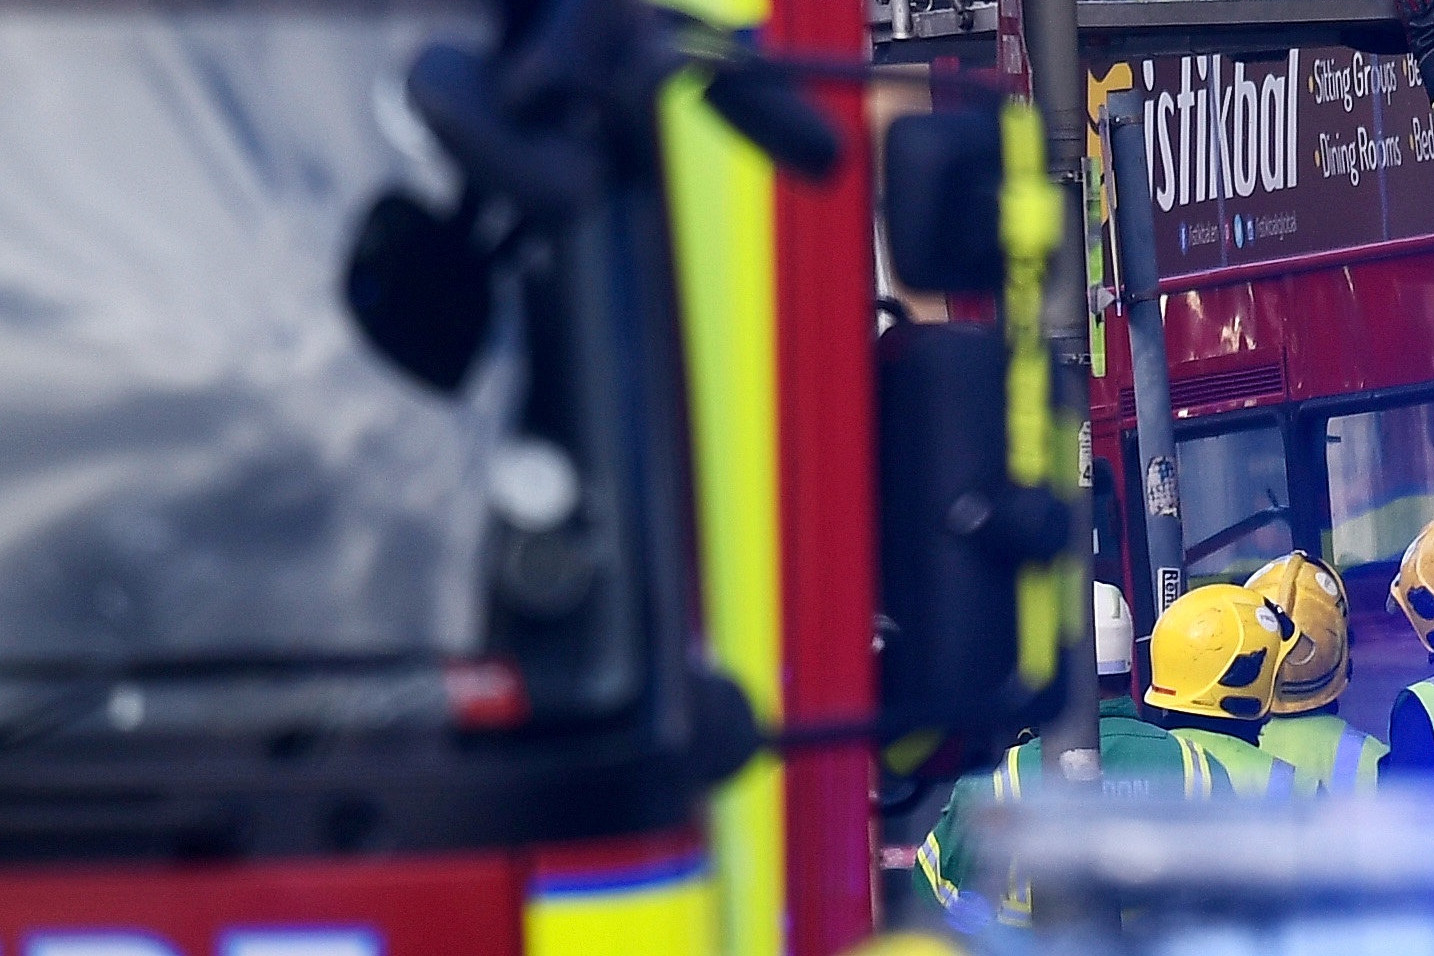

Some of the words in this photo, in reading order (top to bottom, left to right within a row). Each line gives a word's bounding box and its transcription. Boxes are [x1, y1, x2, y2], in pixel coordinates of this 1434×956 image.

[1313, 58, 1353, 112] Sitting
[1353, 51, 1397, 106] Groups
[1319, 133, 1360, 186] Dining
[1357, 127, 1402, 171] Rooms
